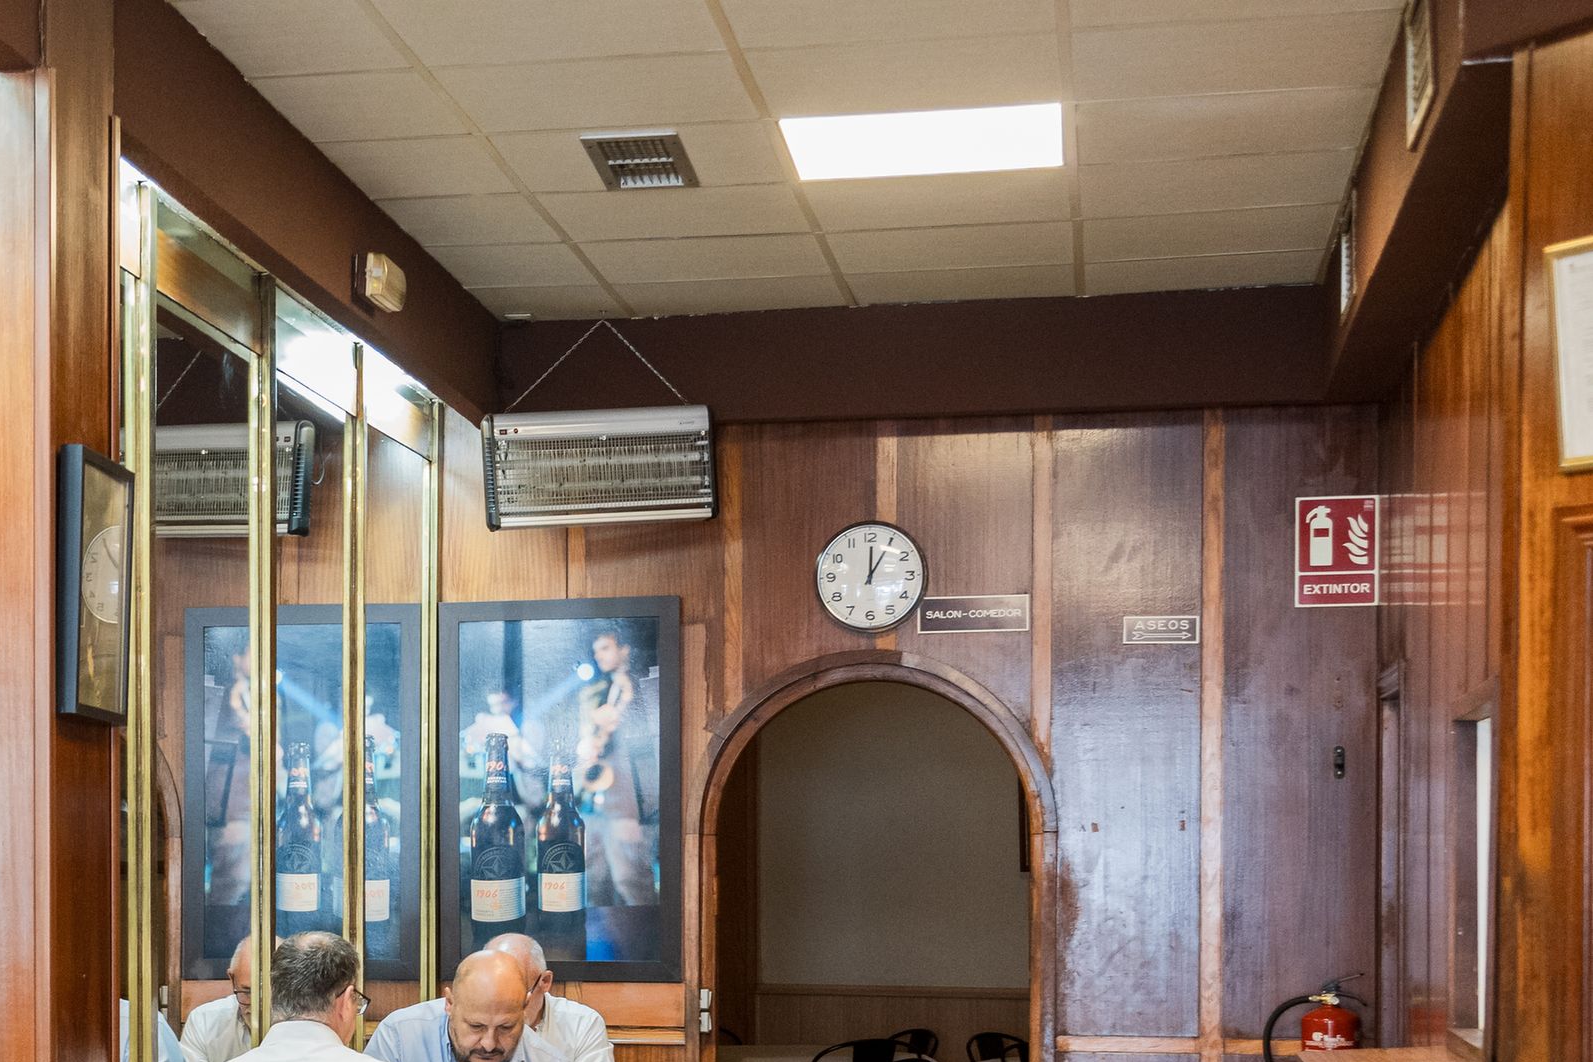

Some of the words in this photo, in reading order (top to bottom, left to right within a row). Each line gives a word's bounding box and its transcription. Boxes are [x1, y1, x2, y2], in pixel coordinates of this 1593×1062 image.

[848, 538, 855, 548] 11
[864, 533, 877, 543] 12
[832, 554, 843, 563] 10
[899, 551, 909, 561] 2
[826, 572, 836, 582] 9
[905, 570, 915, 581] 3
[1303, 583, 1371, 595] EXTINTOR
[831, 592, 842, 602] 8
[899, 591, 909, 600] 4
[846, 605, 855, 616] 7
[885, 605, 895, 615] 5
[926, 608, 1022, 620] SALON-COMEDOR
[865, 611, 875, 621] 6
[1134, 620, 1190, 630] ASEOS
[543, 881, 566, 890] 1906
[476, 888, 498, 898] 1906
